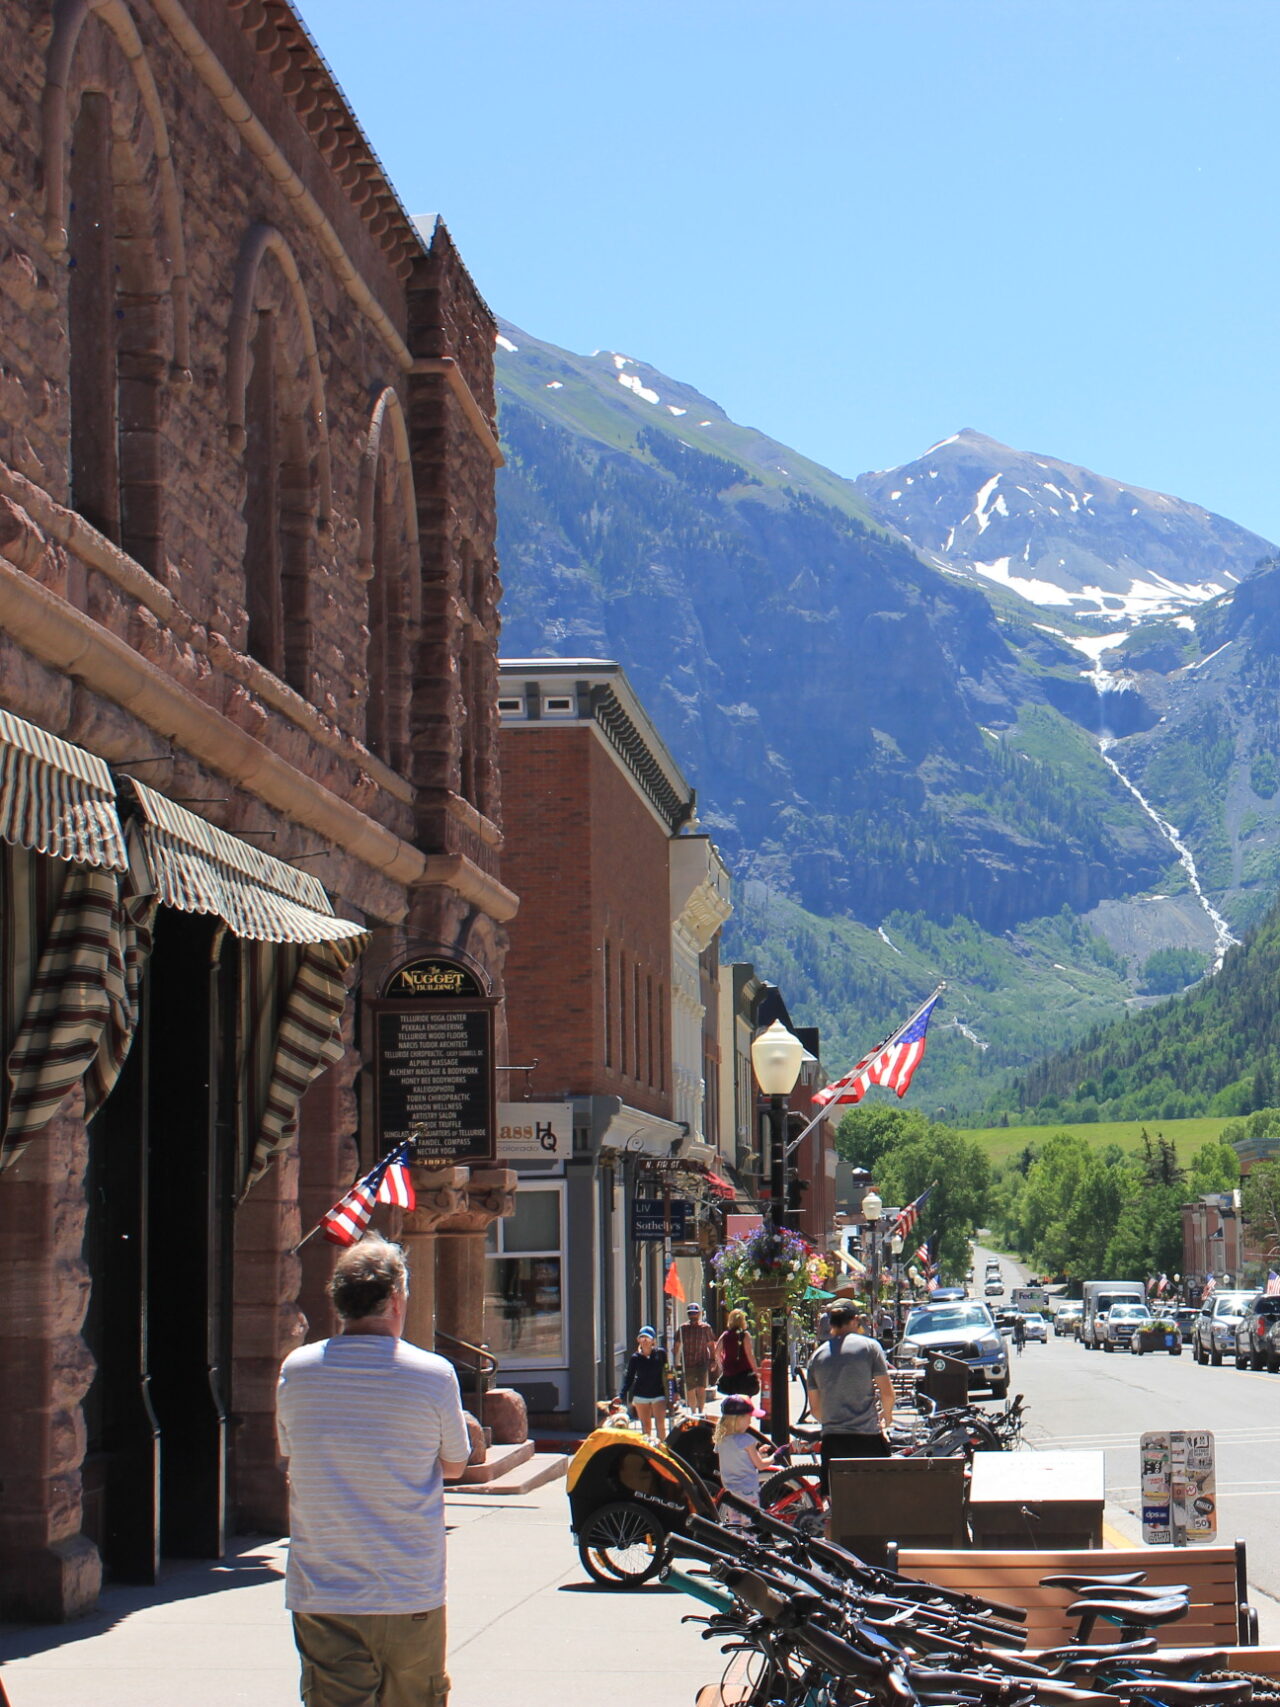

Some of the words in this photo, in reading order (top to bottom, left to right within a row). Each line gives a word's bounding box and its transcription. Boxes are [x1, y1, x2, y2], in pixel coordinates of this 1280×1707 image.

[401, 971, 465, 988] NUGGET
[430, 1014, 444, 1022] YOGA
[440, 1040, 468, 1048] ARCHITECT
[448, 1067, 479, 1075] BODYWORK
[432, 1076, 467, 1084] BODYWORKS
[428, 1093, 470, 1101] CHIROPRACTIC
[411, 1129, 451, 1137] HQUARTERS
[496, 1126, 533, 1139] ass
[536, 1121, 557, 1153] HQ
[656, 1161, 668, 1169] FIR
[636, 1204, 651, 1213] LIV
[634, 1491, 685, 1510] BURLEY
[1195, 1519, 1206, 1527] 50
